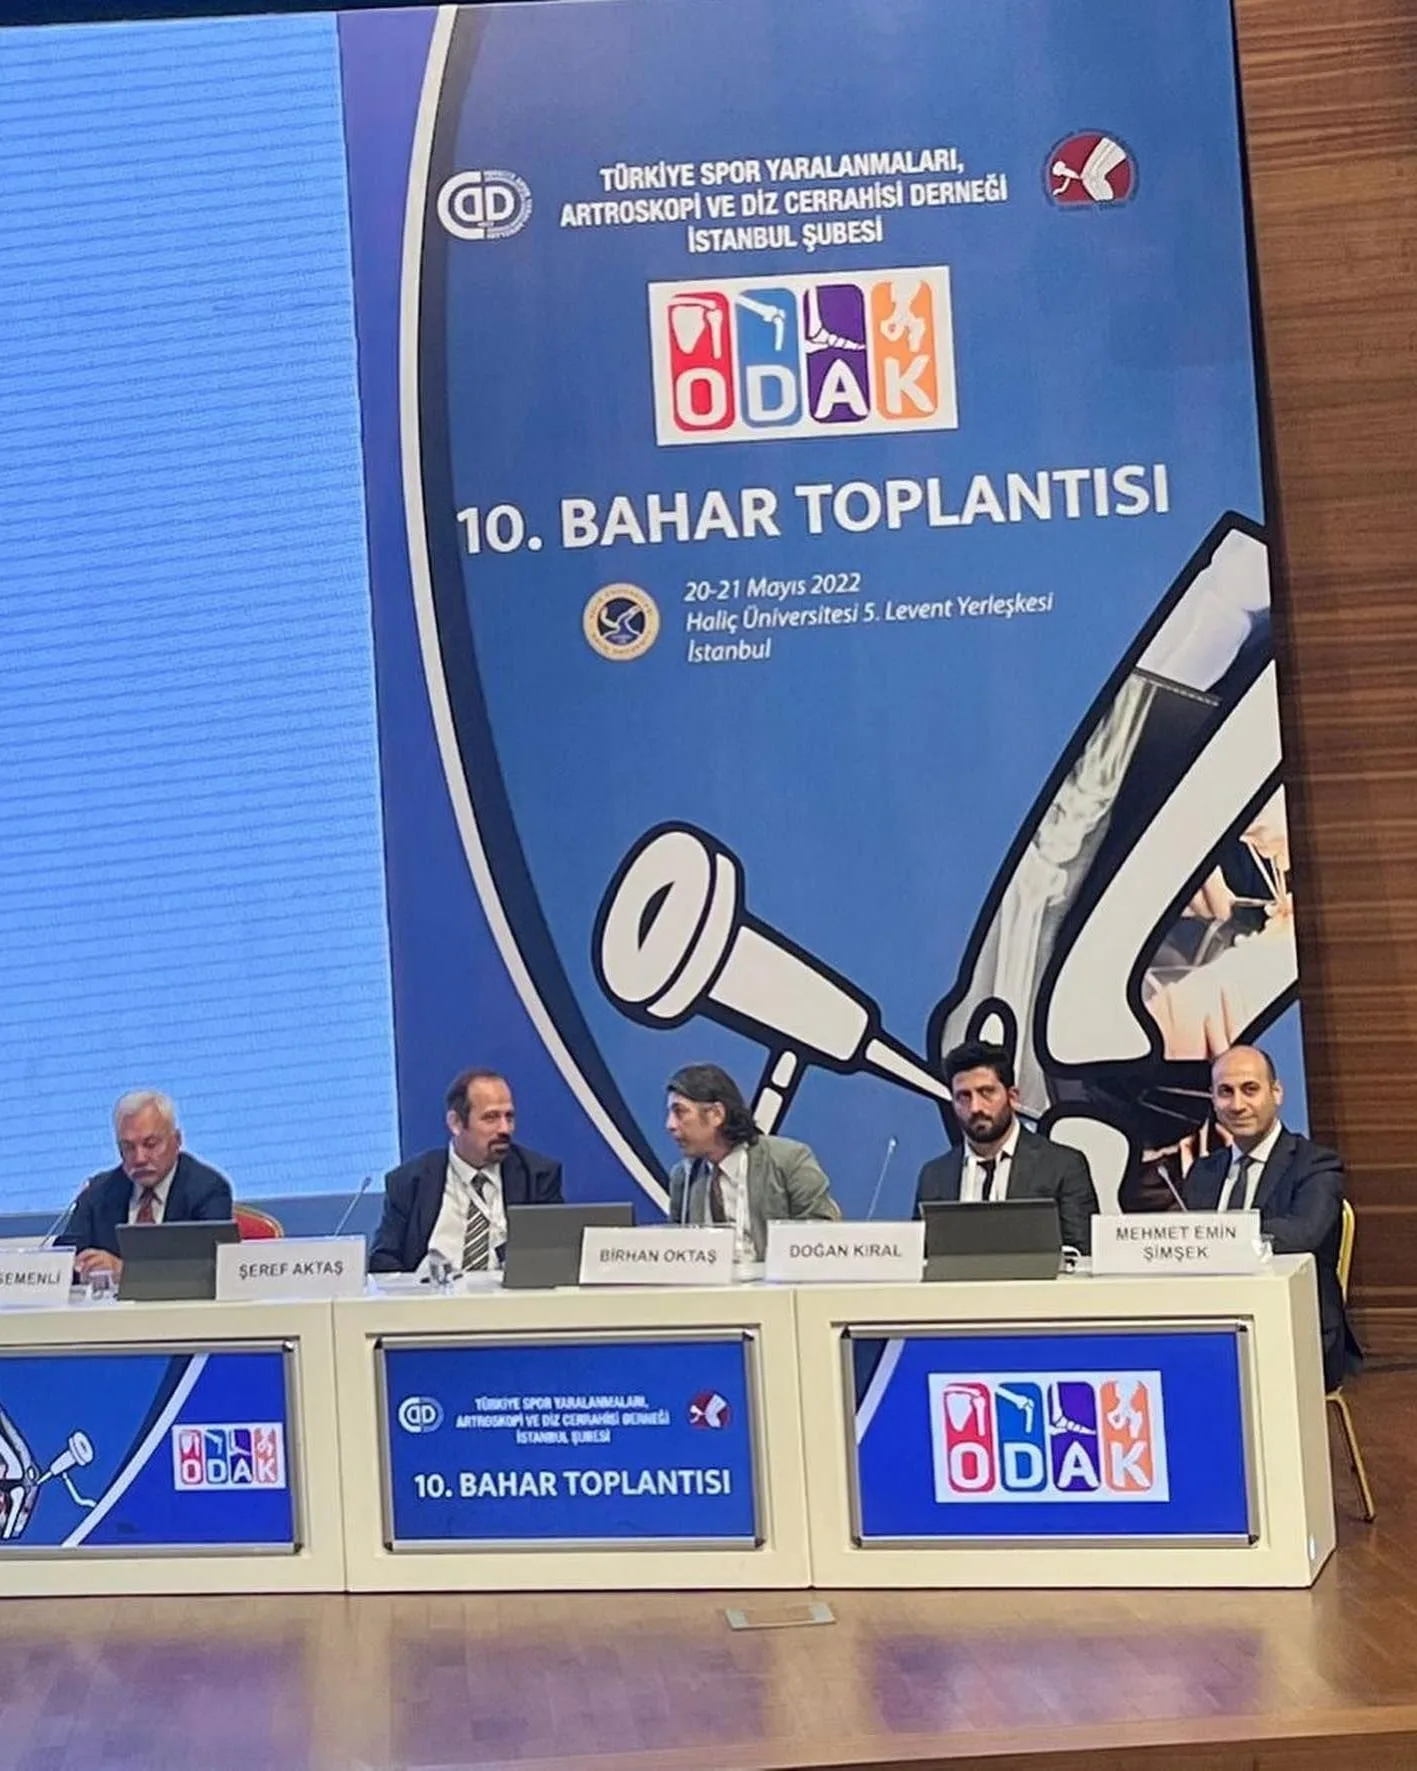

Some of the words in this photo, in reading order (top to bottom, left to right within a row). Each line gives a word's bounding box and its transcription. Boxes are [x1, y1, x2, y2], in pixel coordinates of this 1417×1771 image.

[600, 161, 695, 192] TÜRKİYE
[700, 159, 761, 186] SPOR
[766, 148, 964, 182] YARALANMALARI,
[560, 192, 701, 227] ARTROSKOPİ
[706, 195, 735, 219] VE
[742, 188, 779, 217] DİZ
[784, 180, 904, 214] CERRAHİSİ
[910, 173, 1008, 207] DERNEĞİ
[688, 225, 798, 253] İSTANBUL
[802, 215, 883, 253] ŞUBESİ
[675, 354, 936, 427] ODAK
[456, 505, 543, 555] 10.
[562, 487, 781, 549] BAHAR
[795, 464, 1169, 535] TOPLANTISI
[684, 580, 740, 602] 20-21
[746, 577, 806, 601] Mayıs
[810, 572, 861, 595] 2022
[686, 610, 739, 634] Haliç
[743, 603, 858, 629] Üniversitesi
[863, 602, 880, 622] 5.
[885, 601, 953, 621] Levent
[957, 592, 1055, 619] Yerleşkesi
[1116, 1226, 1190, 1240] MEHMET
[1194, 1225, 1237, 1239] EMİN
[600, 1248, 659, 1262] BİRHAN
[663, 1248, 717, 1264] OKTAŞ
[790, 1243, 848, 1257] DOĞAN
[853, 1244, 902, 1257] KIRAL
[1143, 1246, 1208, 1261] ŞİMŞEK
[239, 1262, 288, 1279] ŞEREF
[292, 1260, 343, 1275] AKTAŞ
[182, 1458, 276, 1482] ODAK
[948, 1441, 1150, 1488] ODAK
[415, 1474, 452, 1498] 10.
[460, 1472, 557, 1497] BAHAR
[563, 1470, 731, 1495] TOPLANTISI
